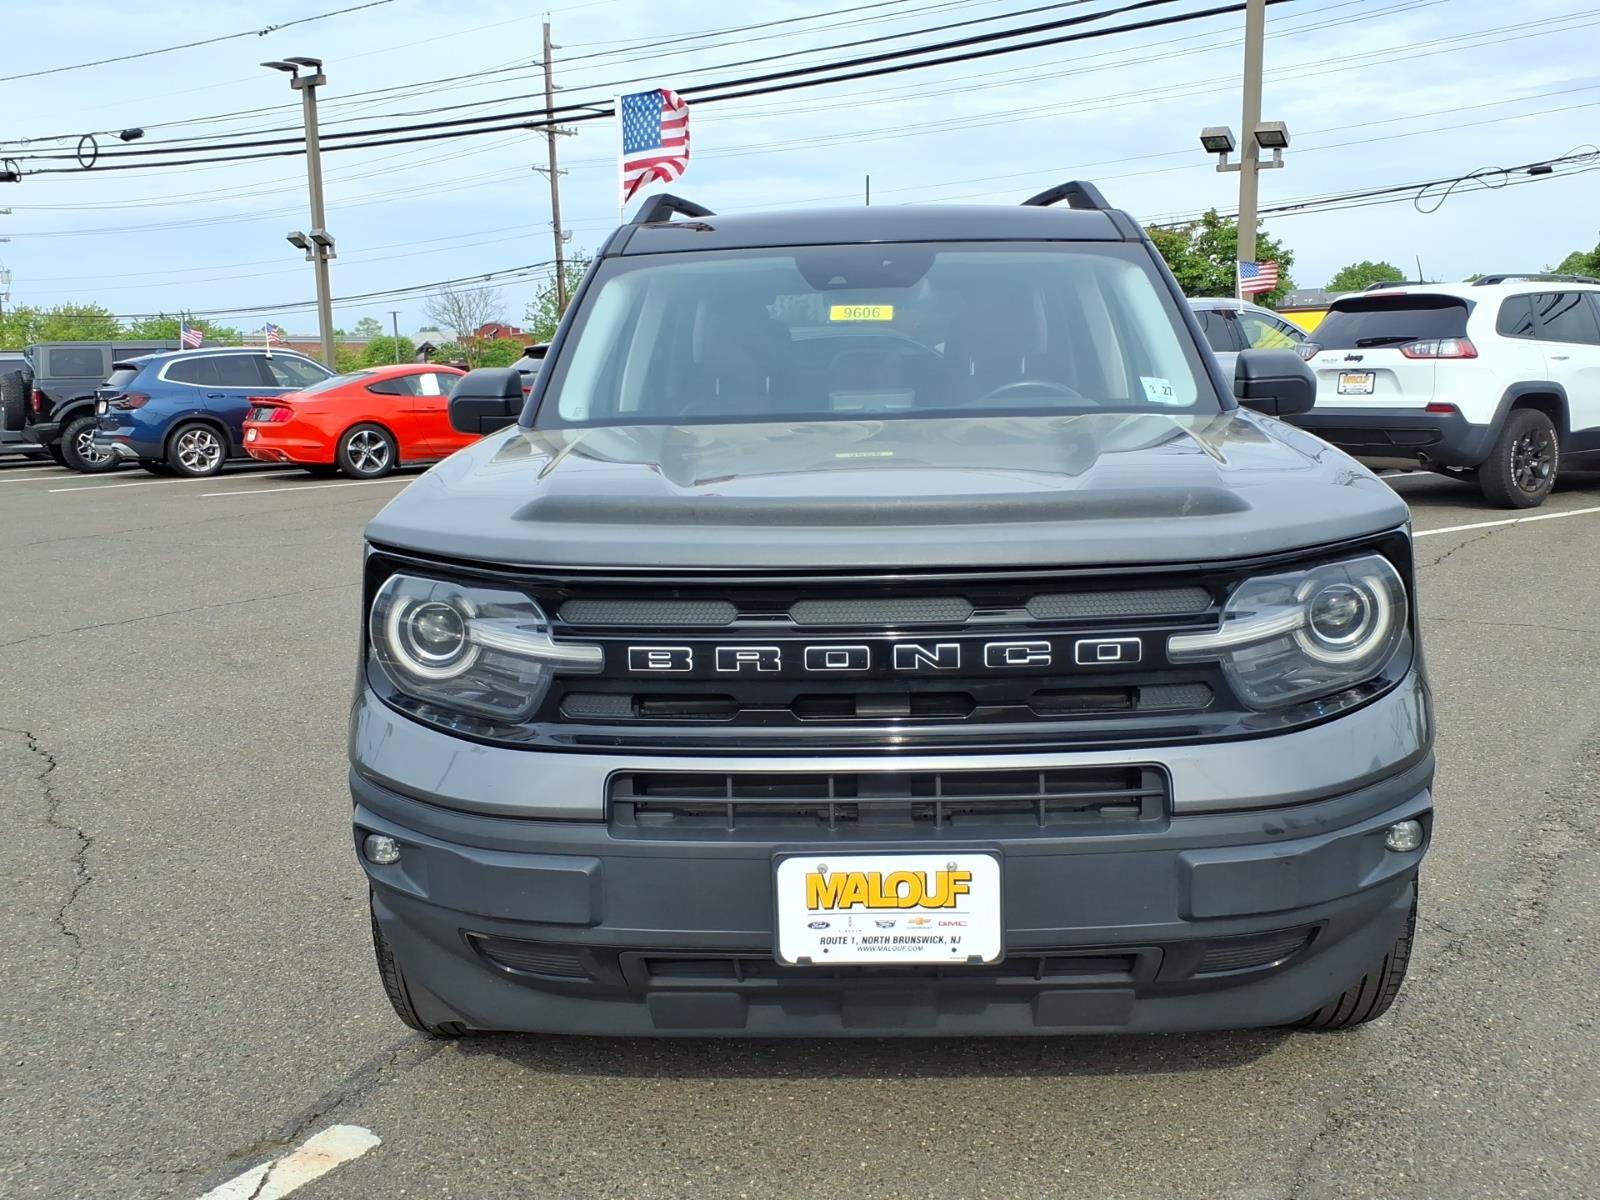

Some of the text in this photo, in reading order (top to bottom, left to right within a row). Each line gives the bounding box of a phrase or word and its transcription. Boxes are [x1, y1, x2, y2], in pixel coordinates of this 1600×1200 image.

[843, 306, 881, 319] 9606
[1161, 385, 1173, 396] 27
[627, 637, 1142, 672] BRONCO
[805, 871, 972, 910] MALOUF
[820, 935, 962, 946] ROUTE 1, NORTH BRUNSWICK, NJ
